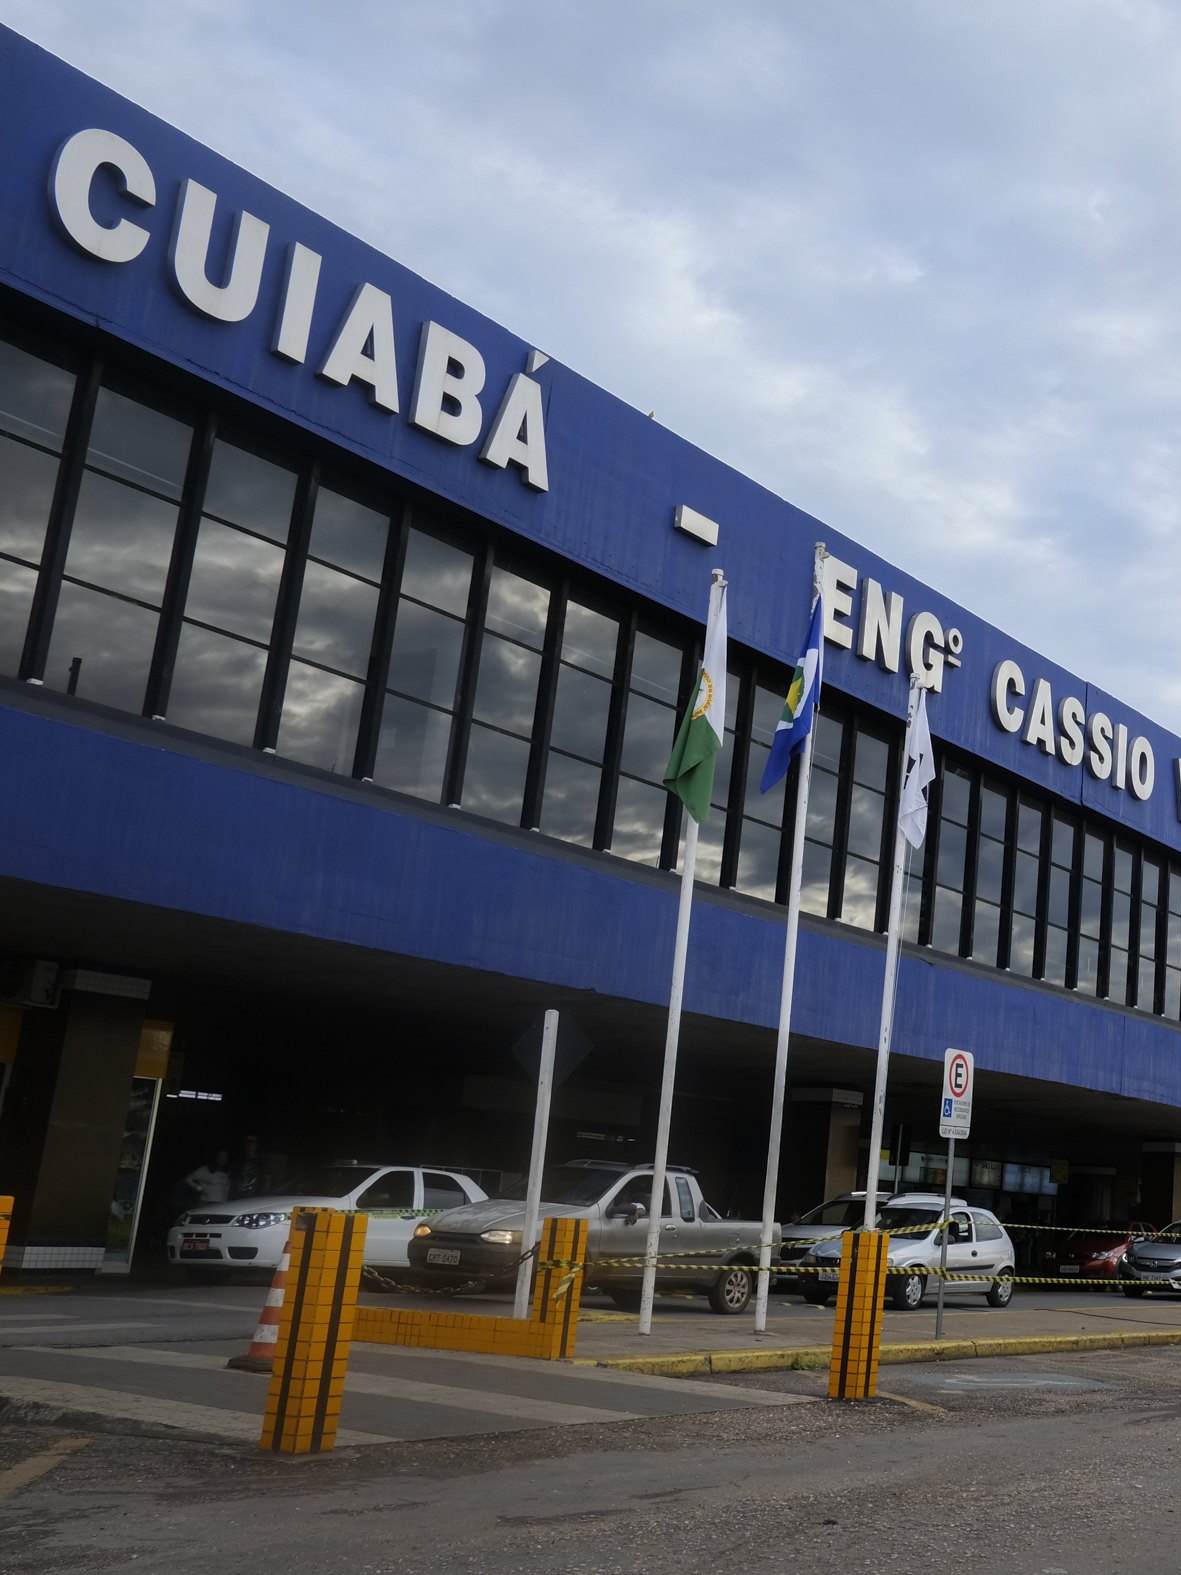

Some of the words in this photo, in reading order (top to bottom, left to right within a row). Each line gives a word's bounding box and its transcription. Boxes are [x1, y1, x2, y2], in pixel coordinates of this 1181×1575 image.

[48, 128, 550, 493] CUIABÁ
[991, 660, 1155, 801] CASSIO
[954, 1063, 964, 1088] E
